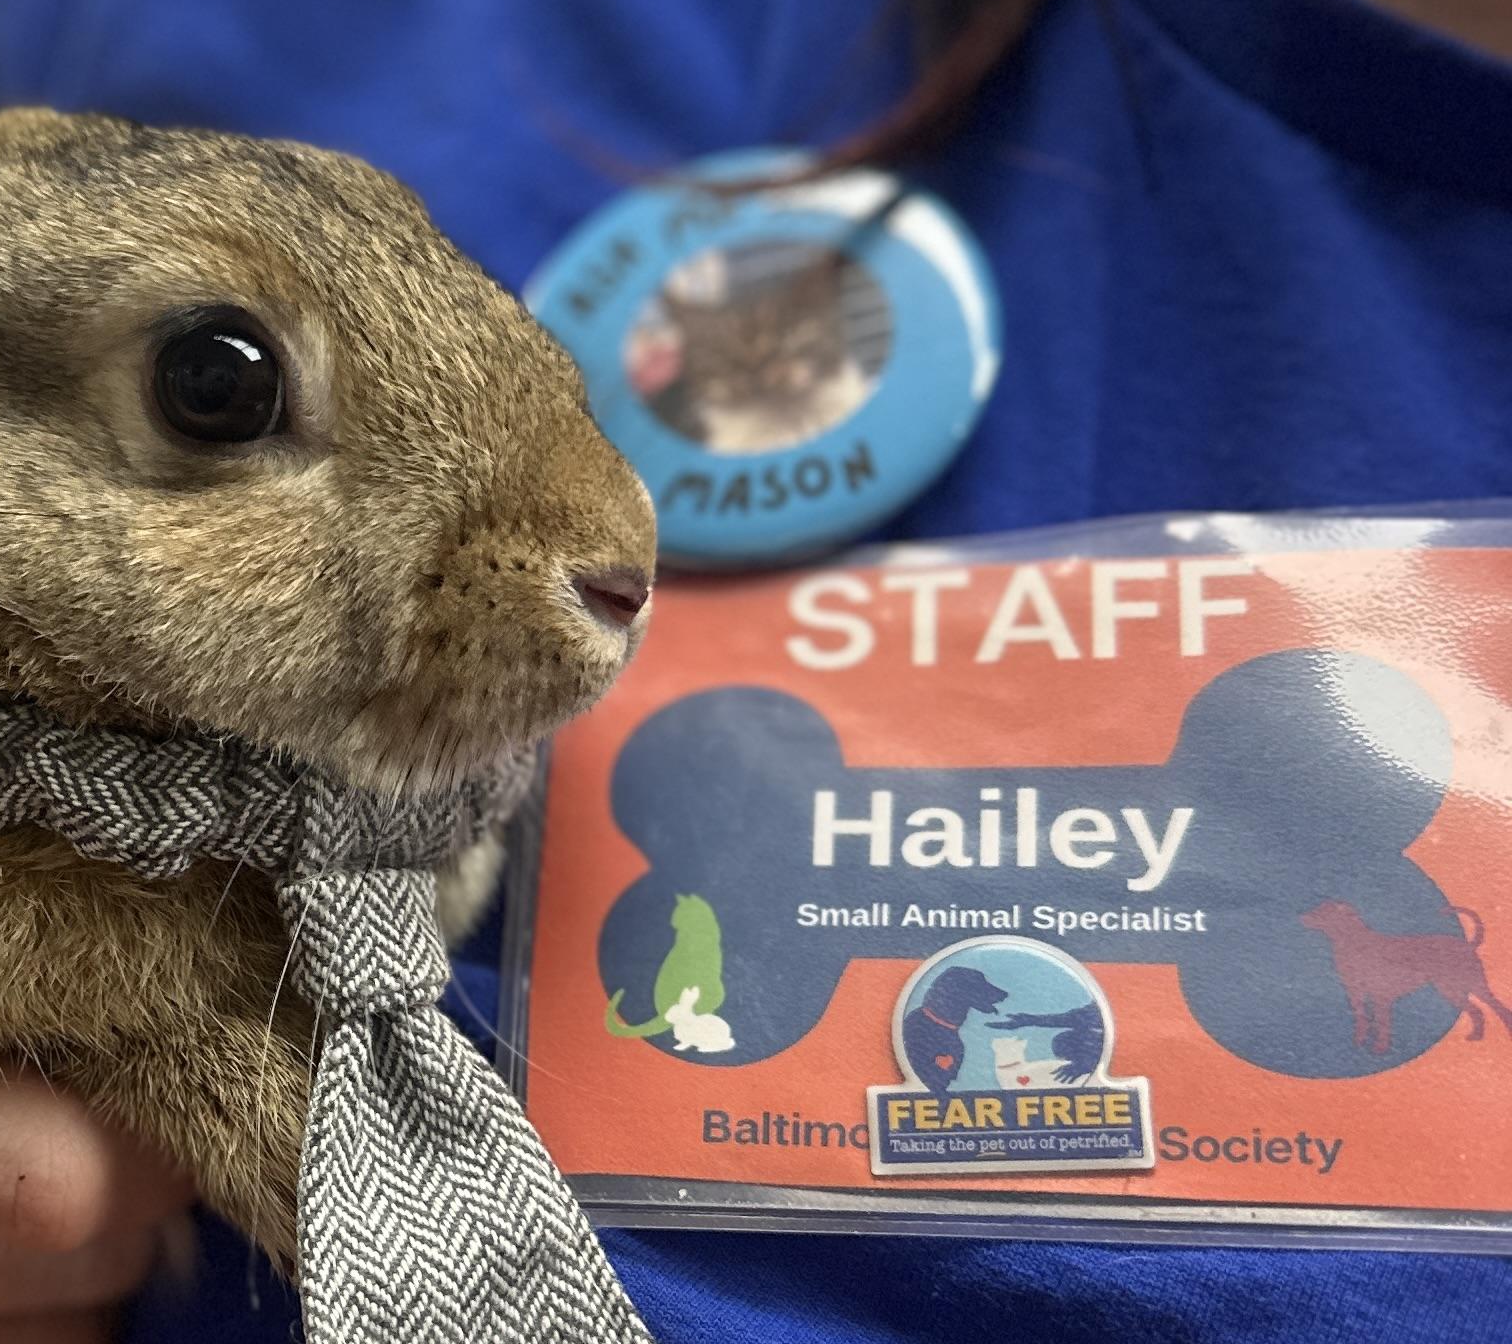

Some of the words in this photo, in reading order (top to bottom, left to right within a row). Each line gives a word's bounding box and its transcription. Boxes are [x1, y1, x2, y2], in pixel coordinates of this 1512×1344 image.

[662, 439, 879, 516] MASON
[785, 560, 1255, 670] STAFF
[812, 787, 1194, 892] Hailey
[796, 902, 889, 927] Small
[901, 903, 1020, 929] Animal
[1031, 905, 1207, 936] Specialist
[702, 1109, 870, 1150] Baltimo
[1158, 1126, 1343, 1174] Society
[888, 1096, 1005, 1131] FEAR
[1016, 1093, 1133, 1127] FREE
[890, 1138, 945, 1153] Taking
[949, 1135, 976, 1151] the
[980, 1137, 1006, 1155] pet
[1009, 1136, 1034, 1150] out
[1039, 1133, 1056, 1149] of
[1059, 1132, 1135, 1150] petrified.
